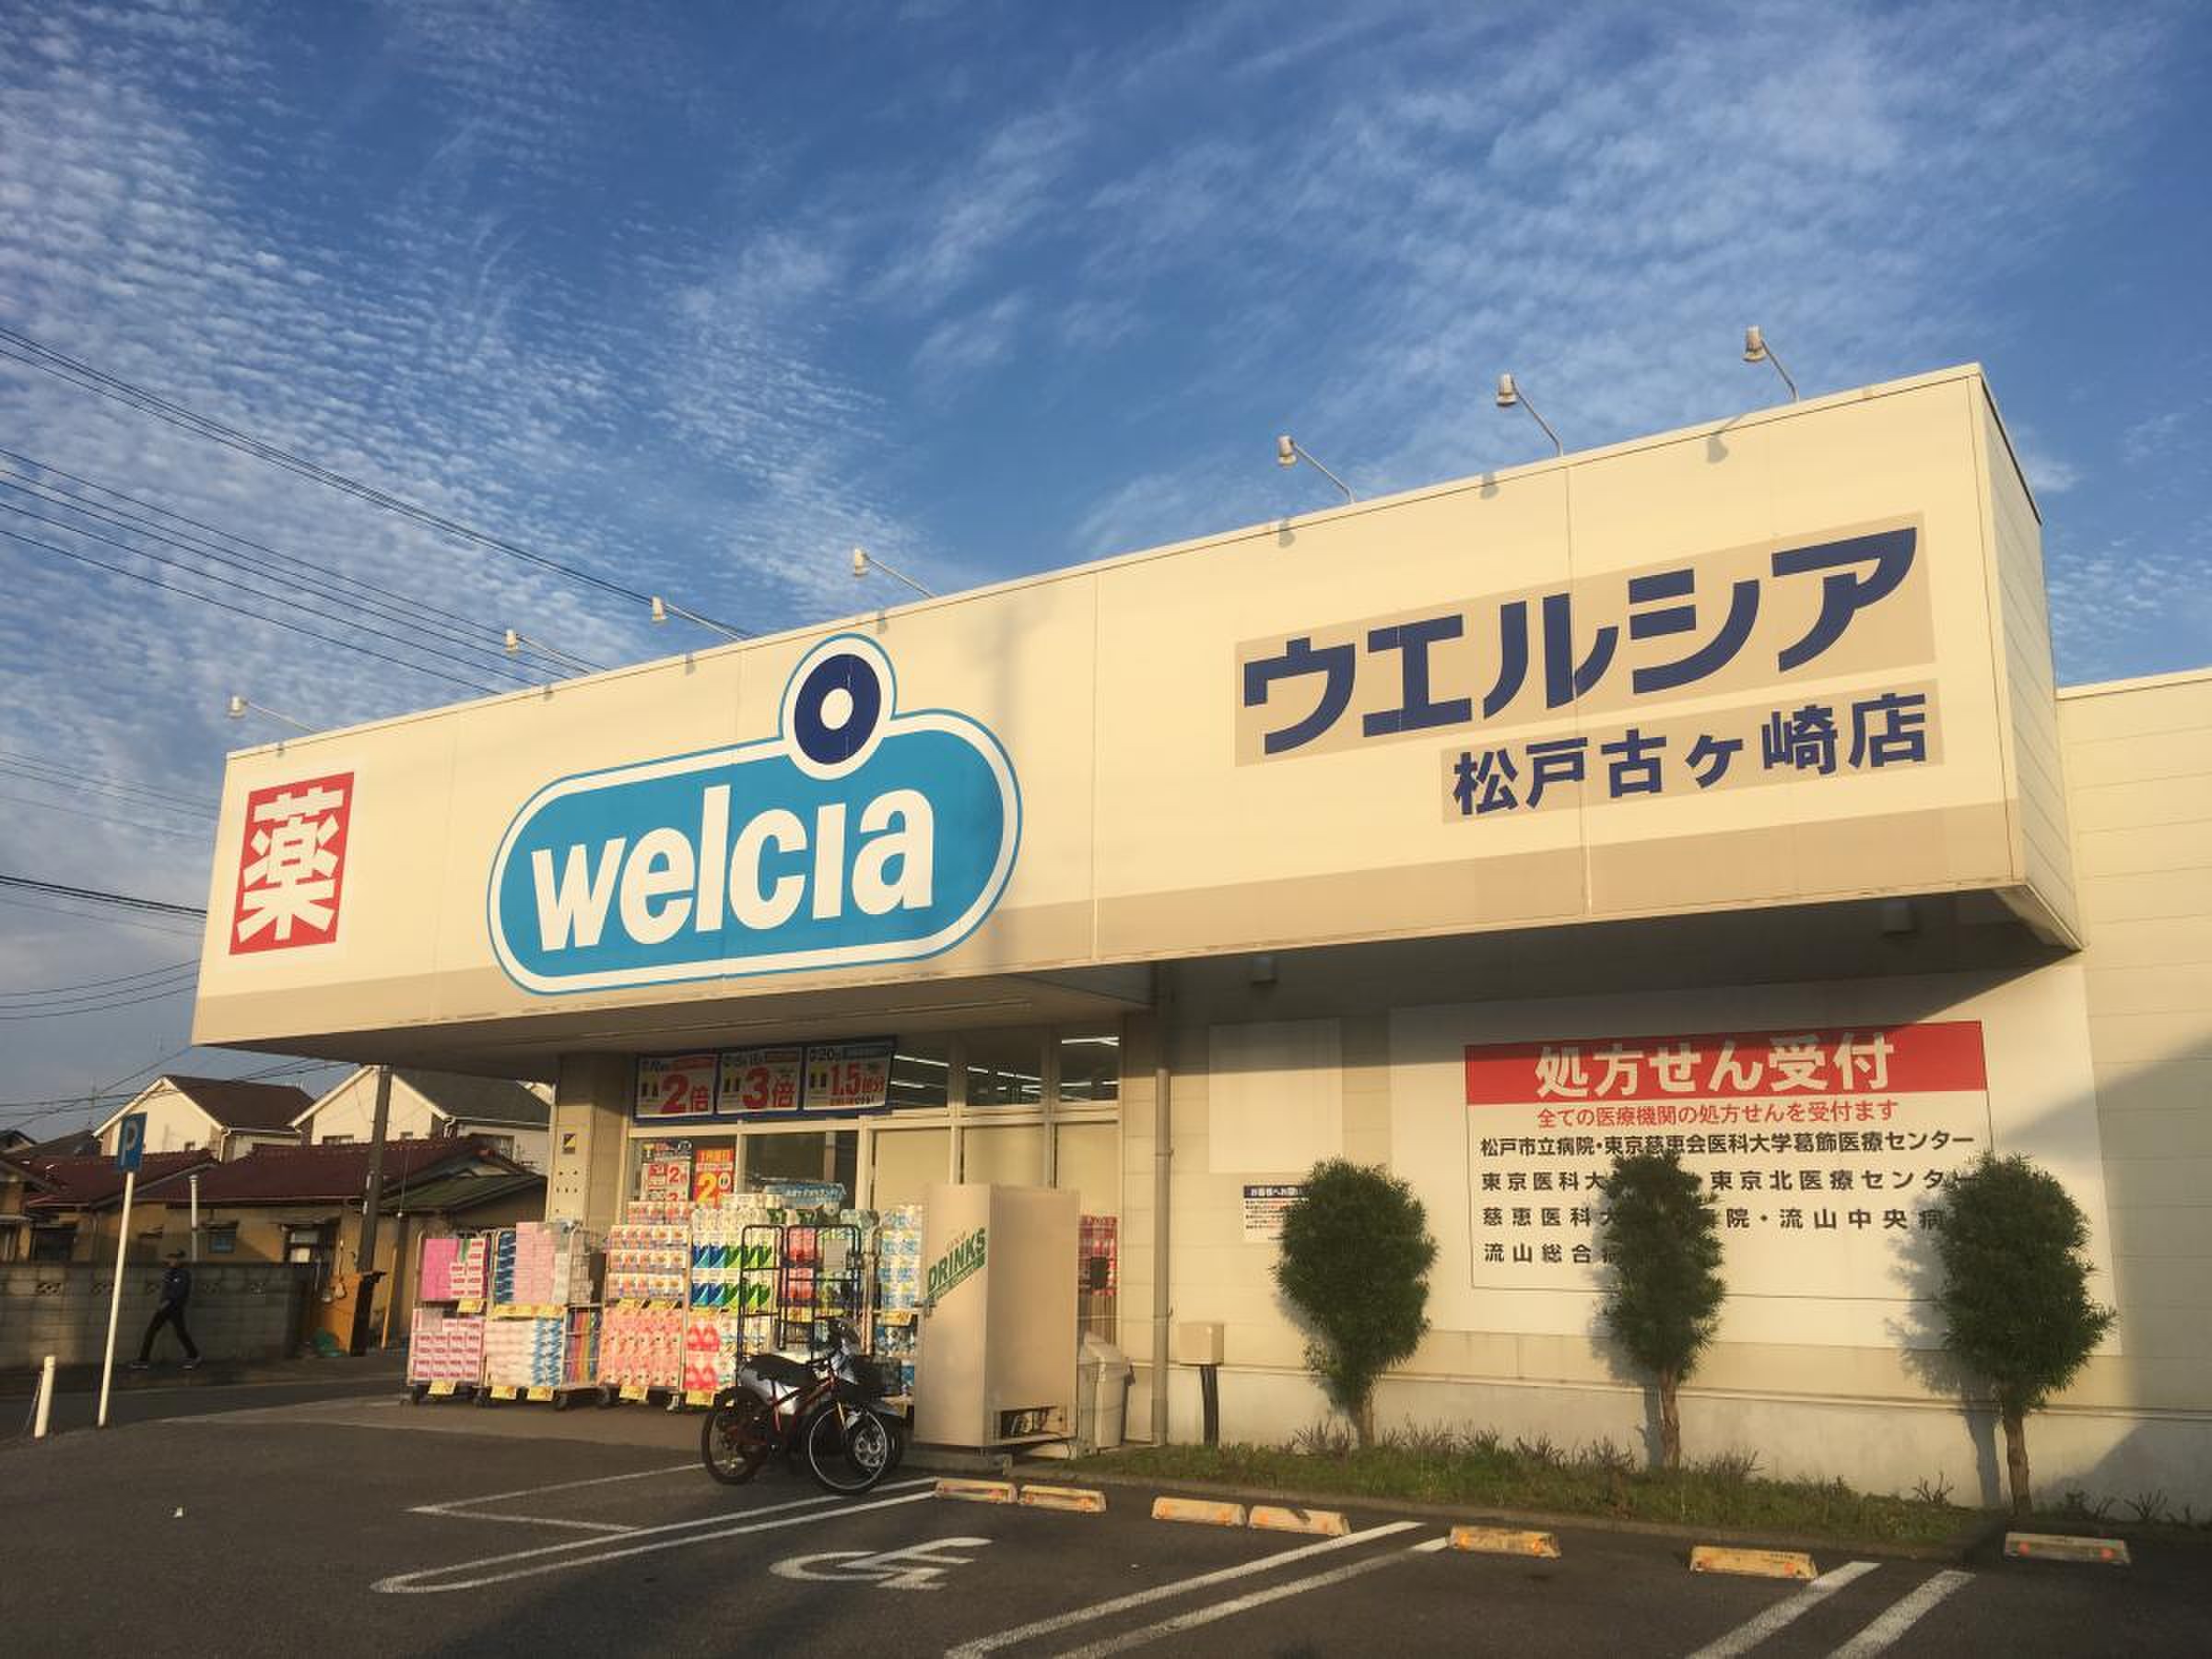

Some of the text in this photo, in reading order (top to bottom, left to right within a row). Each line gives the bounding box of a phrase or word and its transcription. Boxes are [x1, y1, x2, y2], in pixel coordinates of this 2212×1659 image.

[1244, 527, 1916, 755] ウエルシア
[237, 785, 345, 942] 薬
[532, 784, 935, 951] welcia
[1535, 1031, 1895, 1098] 処方せん受付
[121, 1120, 138, 1166] P
[1537, 1100, 1899, 1129] 全ての医療機関の処方せんを受付ます
[927, 1227, 986, 1293] DRINKS
